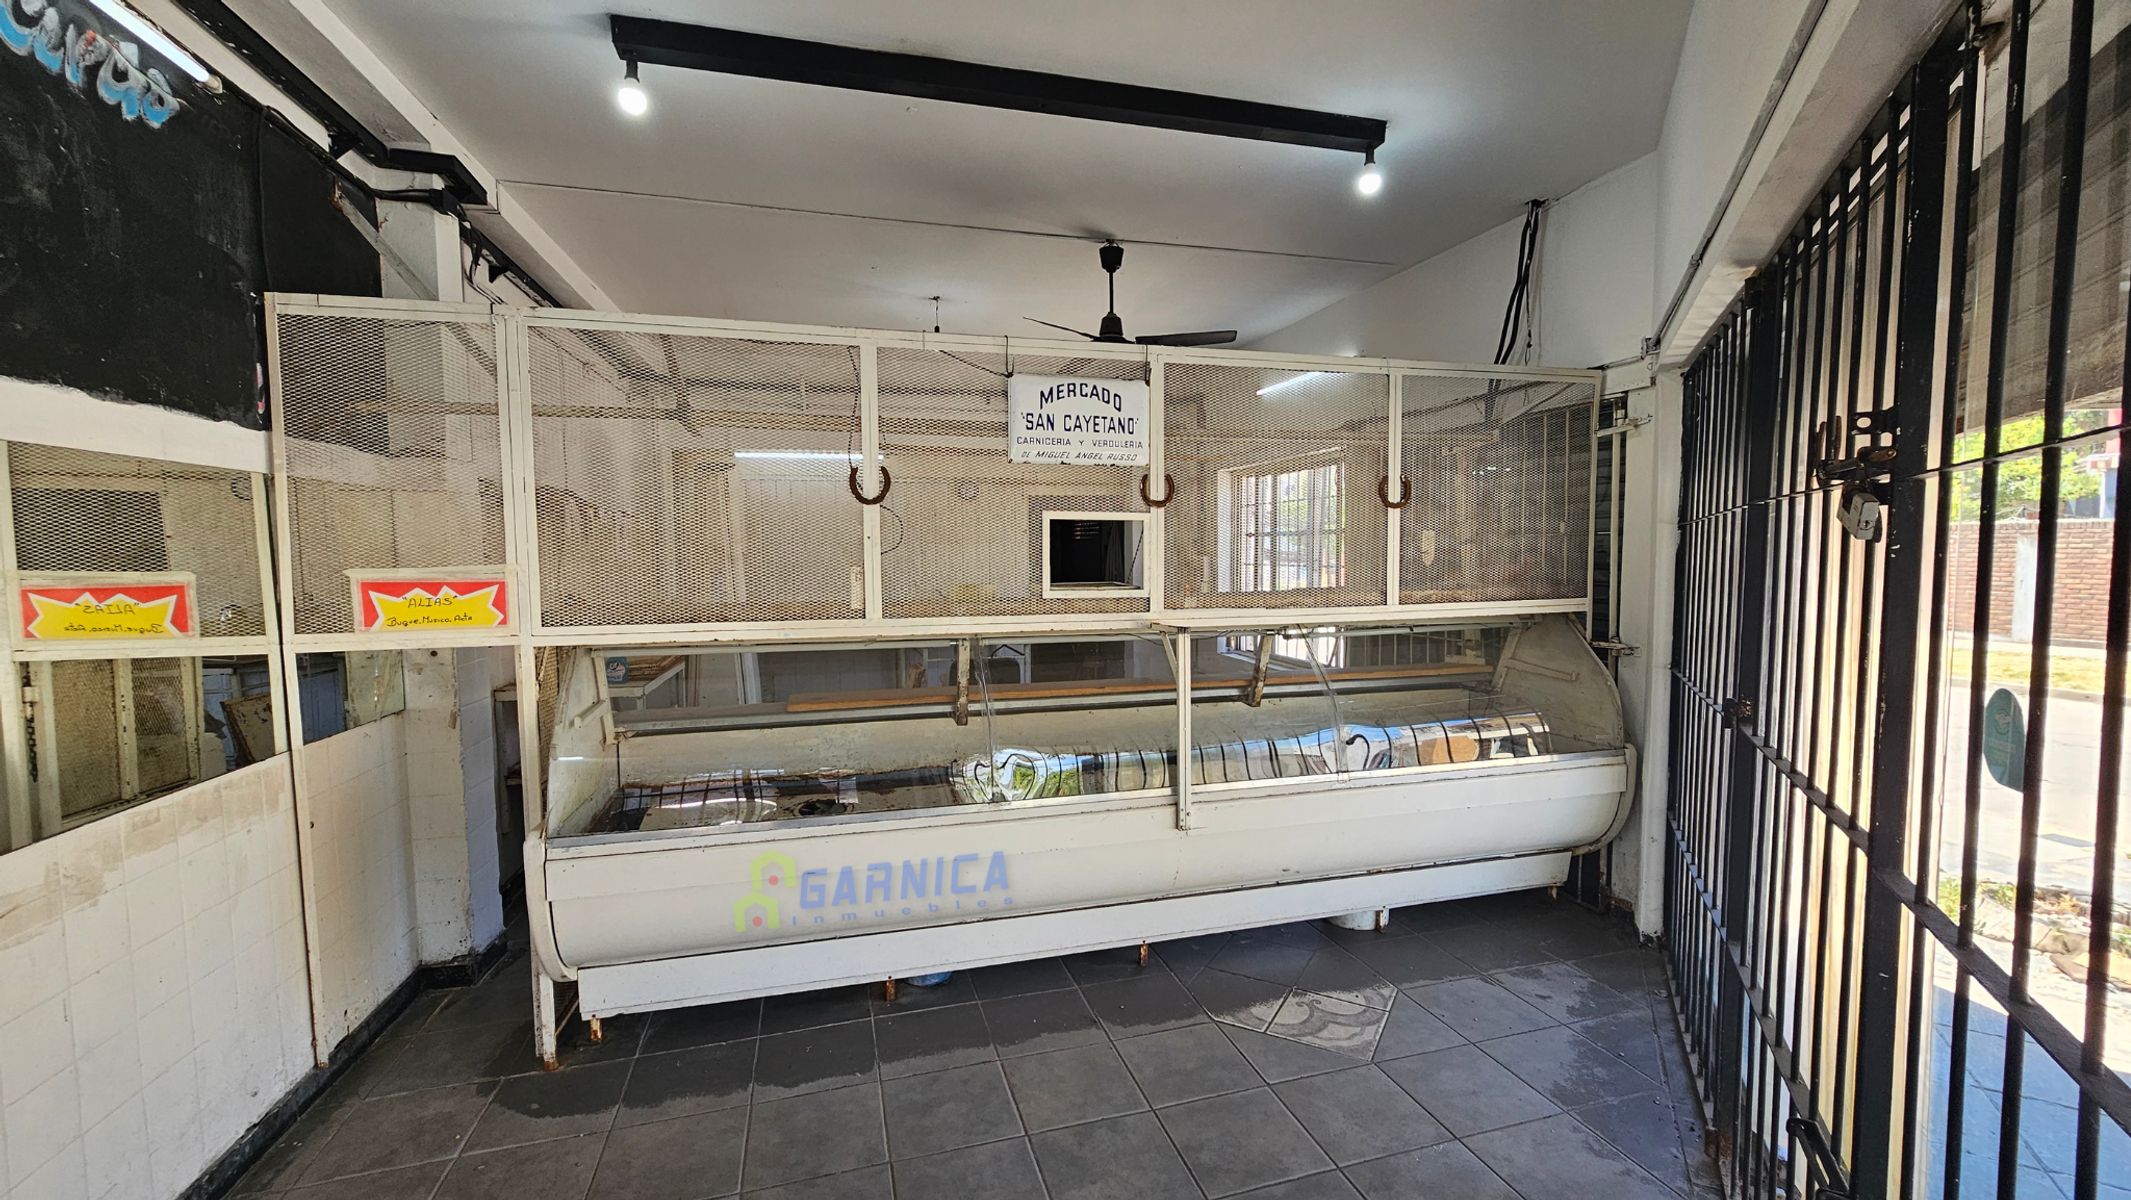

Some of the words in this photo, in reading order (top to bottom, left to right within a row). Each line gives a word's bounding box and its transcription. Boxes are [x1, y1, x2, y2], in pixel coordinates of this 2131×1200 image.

[1039, 382, 1122, 412] MERCADO
[1016, 436, 1072, 446] CARNICERIA
[1091, 439, 1143, 449] VERDULERIA
[1035, 451, 1071, 459] MIGUEL
[1075, 451, 1104, 460] ANGEL
[1107, 453, 1138, 461] RUSSO
